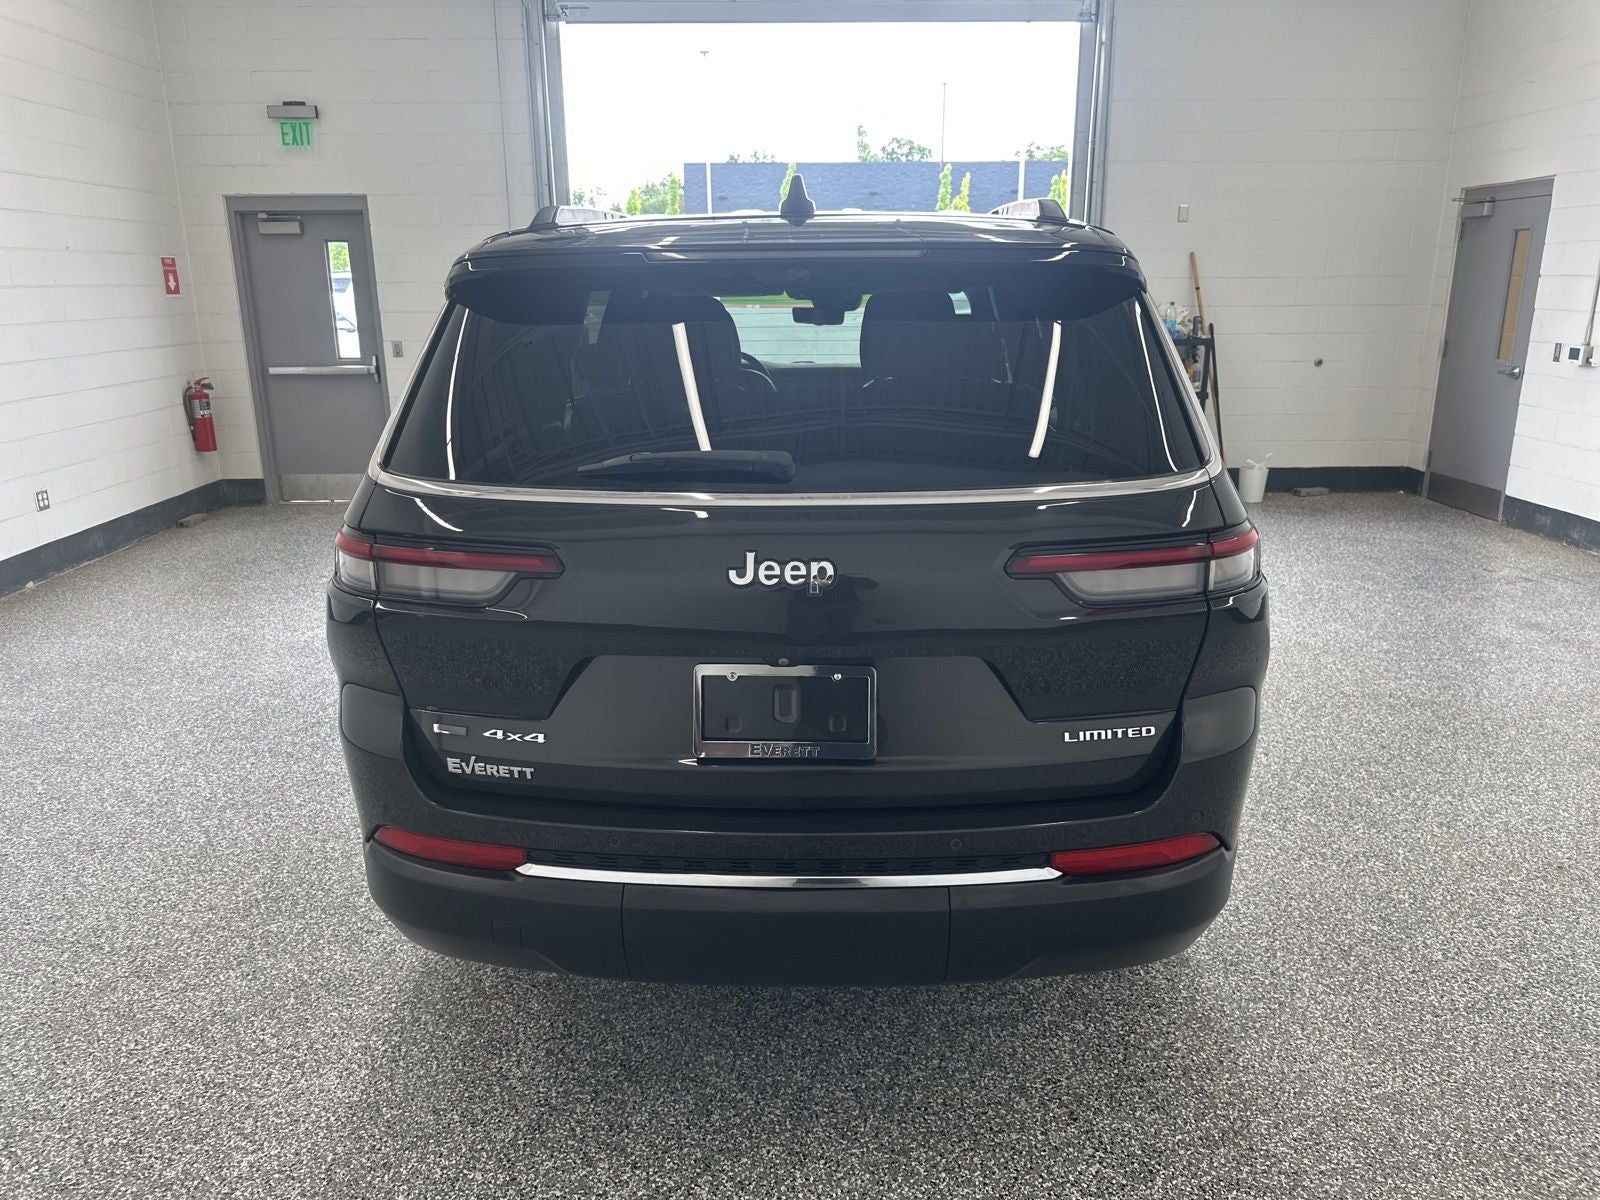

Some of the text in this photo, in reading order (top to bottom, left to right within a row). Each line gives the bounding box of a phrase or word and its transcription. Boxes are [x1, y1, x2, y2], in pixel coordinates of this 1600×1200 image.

[280, 121, 311, 146] EXIT
[728, 551, 835, 593] Jeep
[1064, 726, 1156, 743] LIMITED
[748, 743, 821, 758] EVERETT
[446, 756, 535, 780] EVERETT
